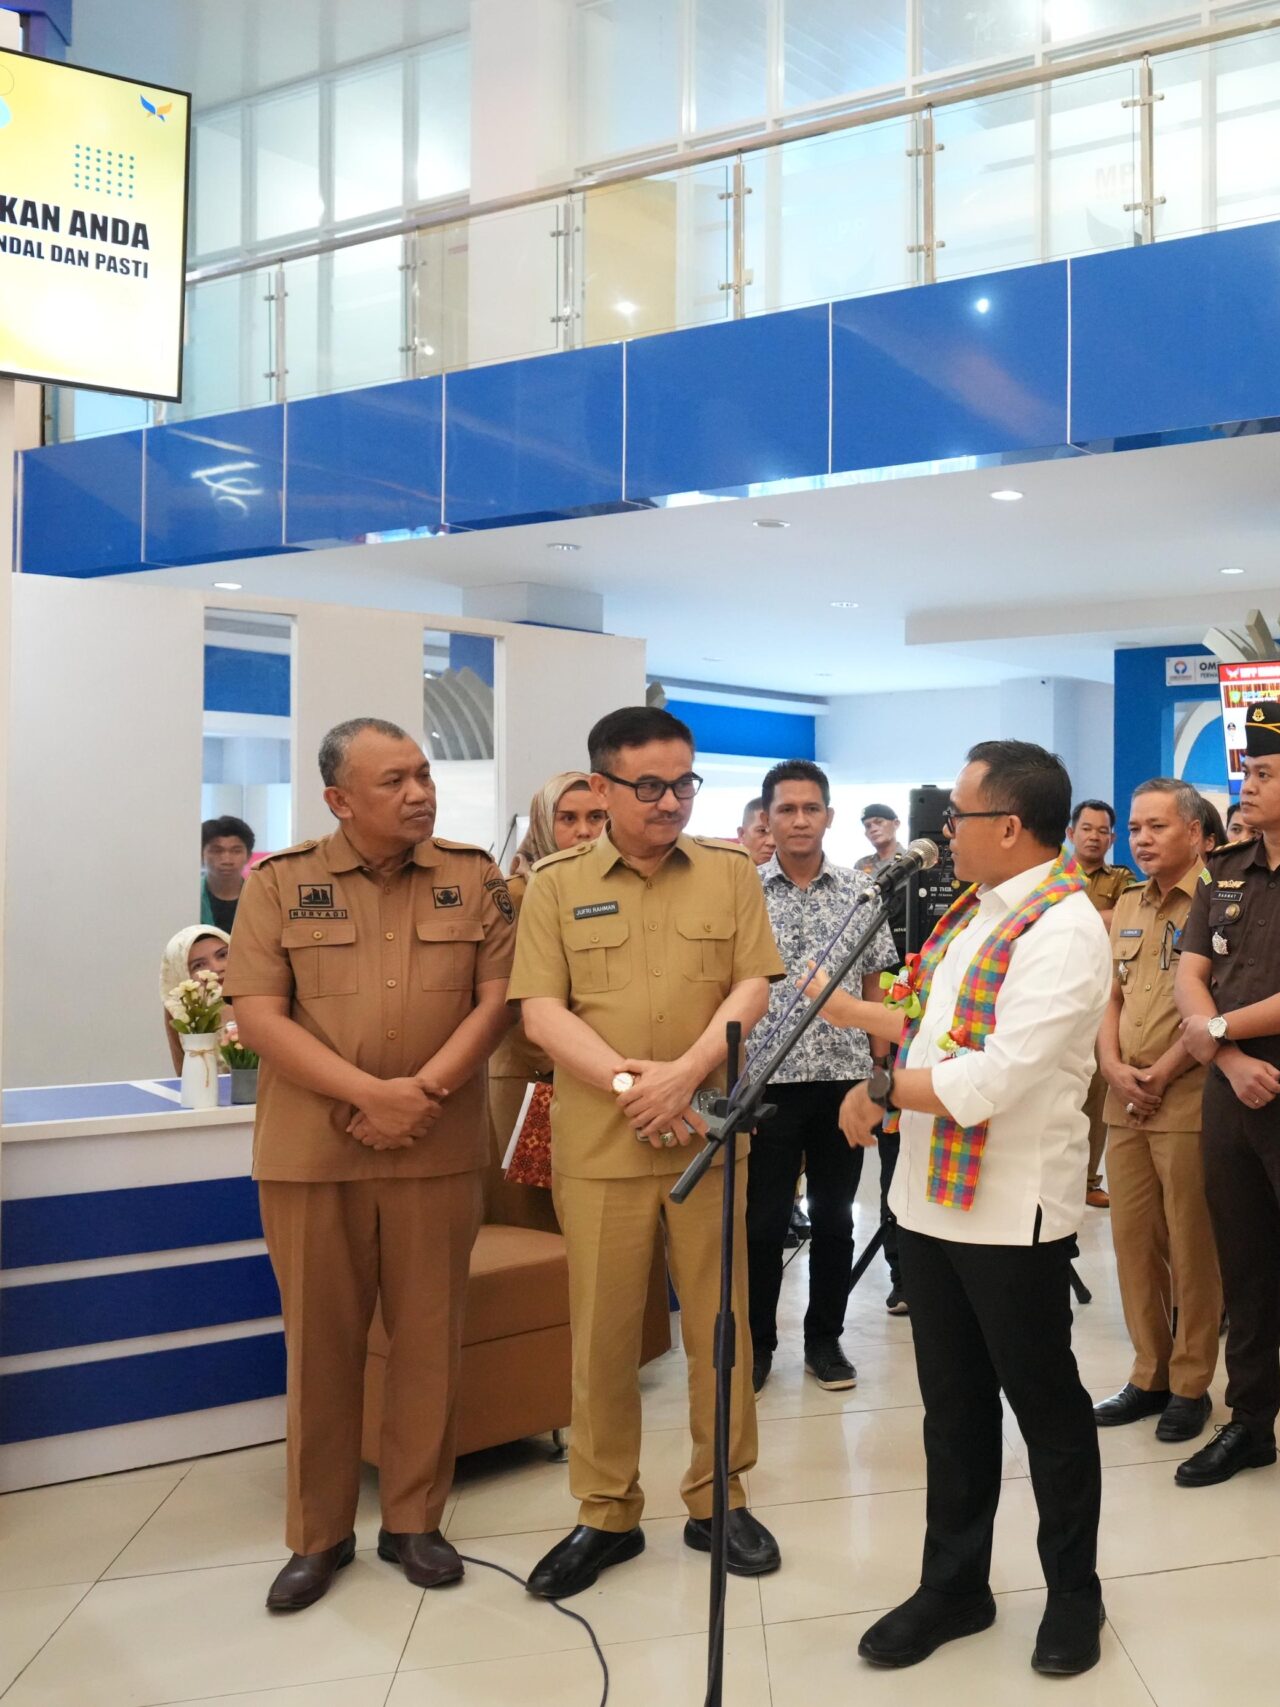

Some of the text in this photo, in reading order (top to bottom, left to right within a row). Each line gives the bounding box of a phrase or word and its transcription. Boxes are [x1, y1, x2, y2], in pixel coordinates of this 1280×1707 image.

[0, 194, 150, 251] KAN ANDA
[51, 244, 89, 268] DAN
[95, 252, 149, 279] PASTI
[1199, 662, 1217, 671] OM
[576, 904, 616, 916] JUFRI RAHMAN
